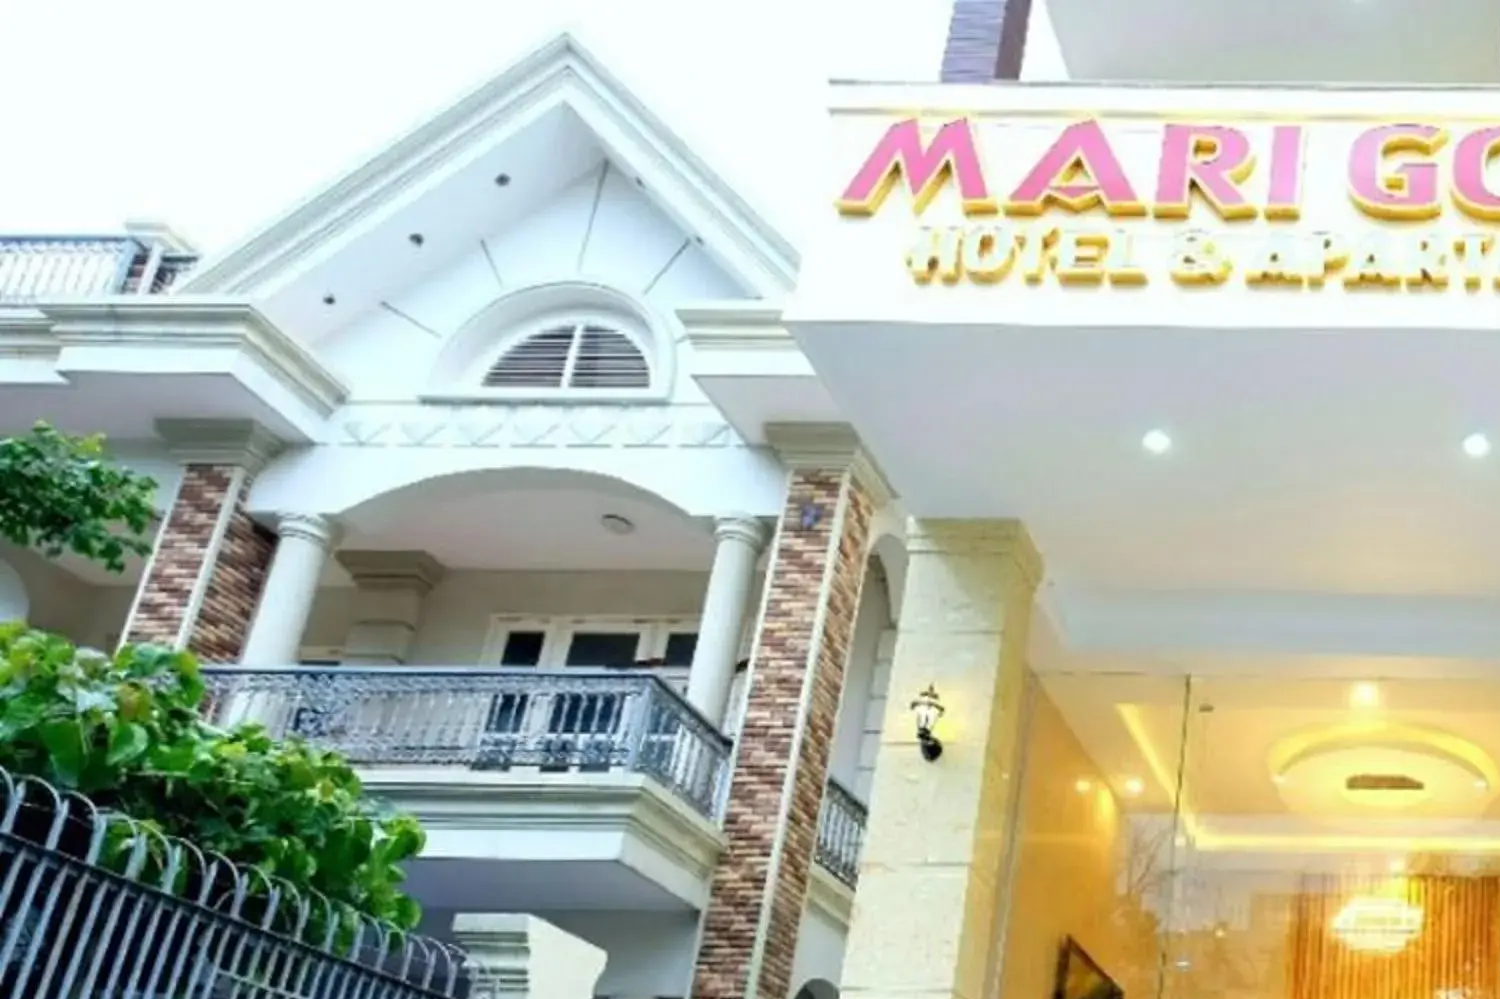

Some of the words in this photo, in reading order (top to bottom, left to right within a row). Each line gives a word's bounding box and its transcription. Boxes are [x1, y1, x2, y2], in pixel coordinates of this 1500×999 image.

[837, 117, 1303, 222] MARI
[906, 225, 1148, 287] HOTEL
[1169, 229, 1234, 287] &
